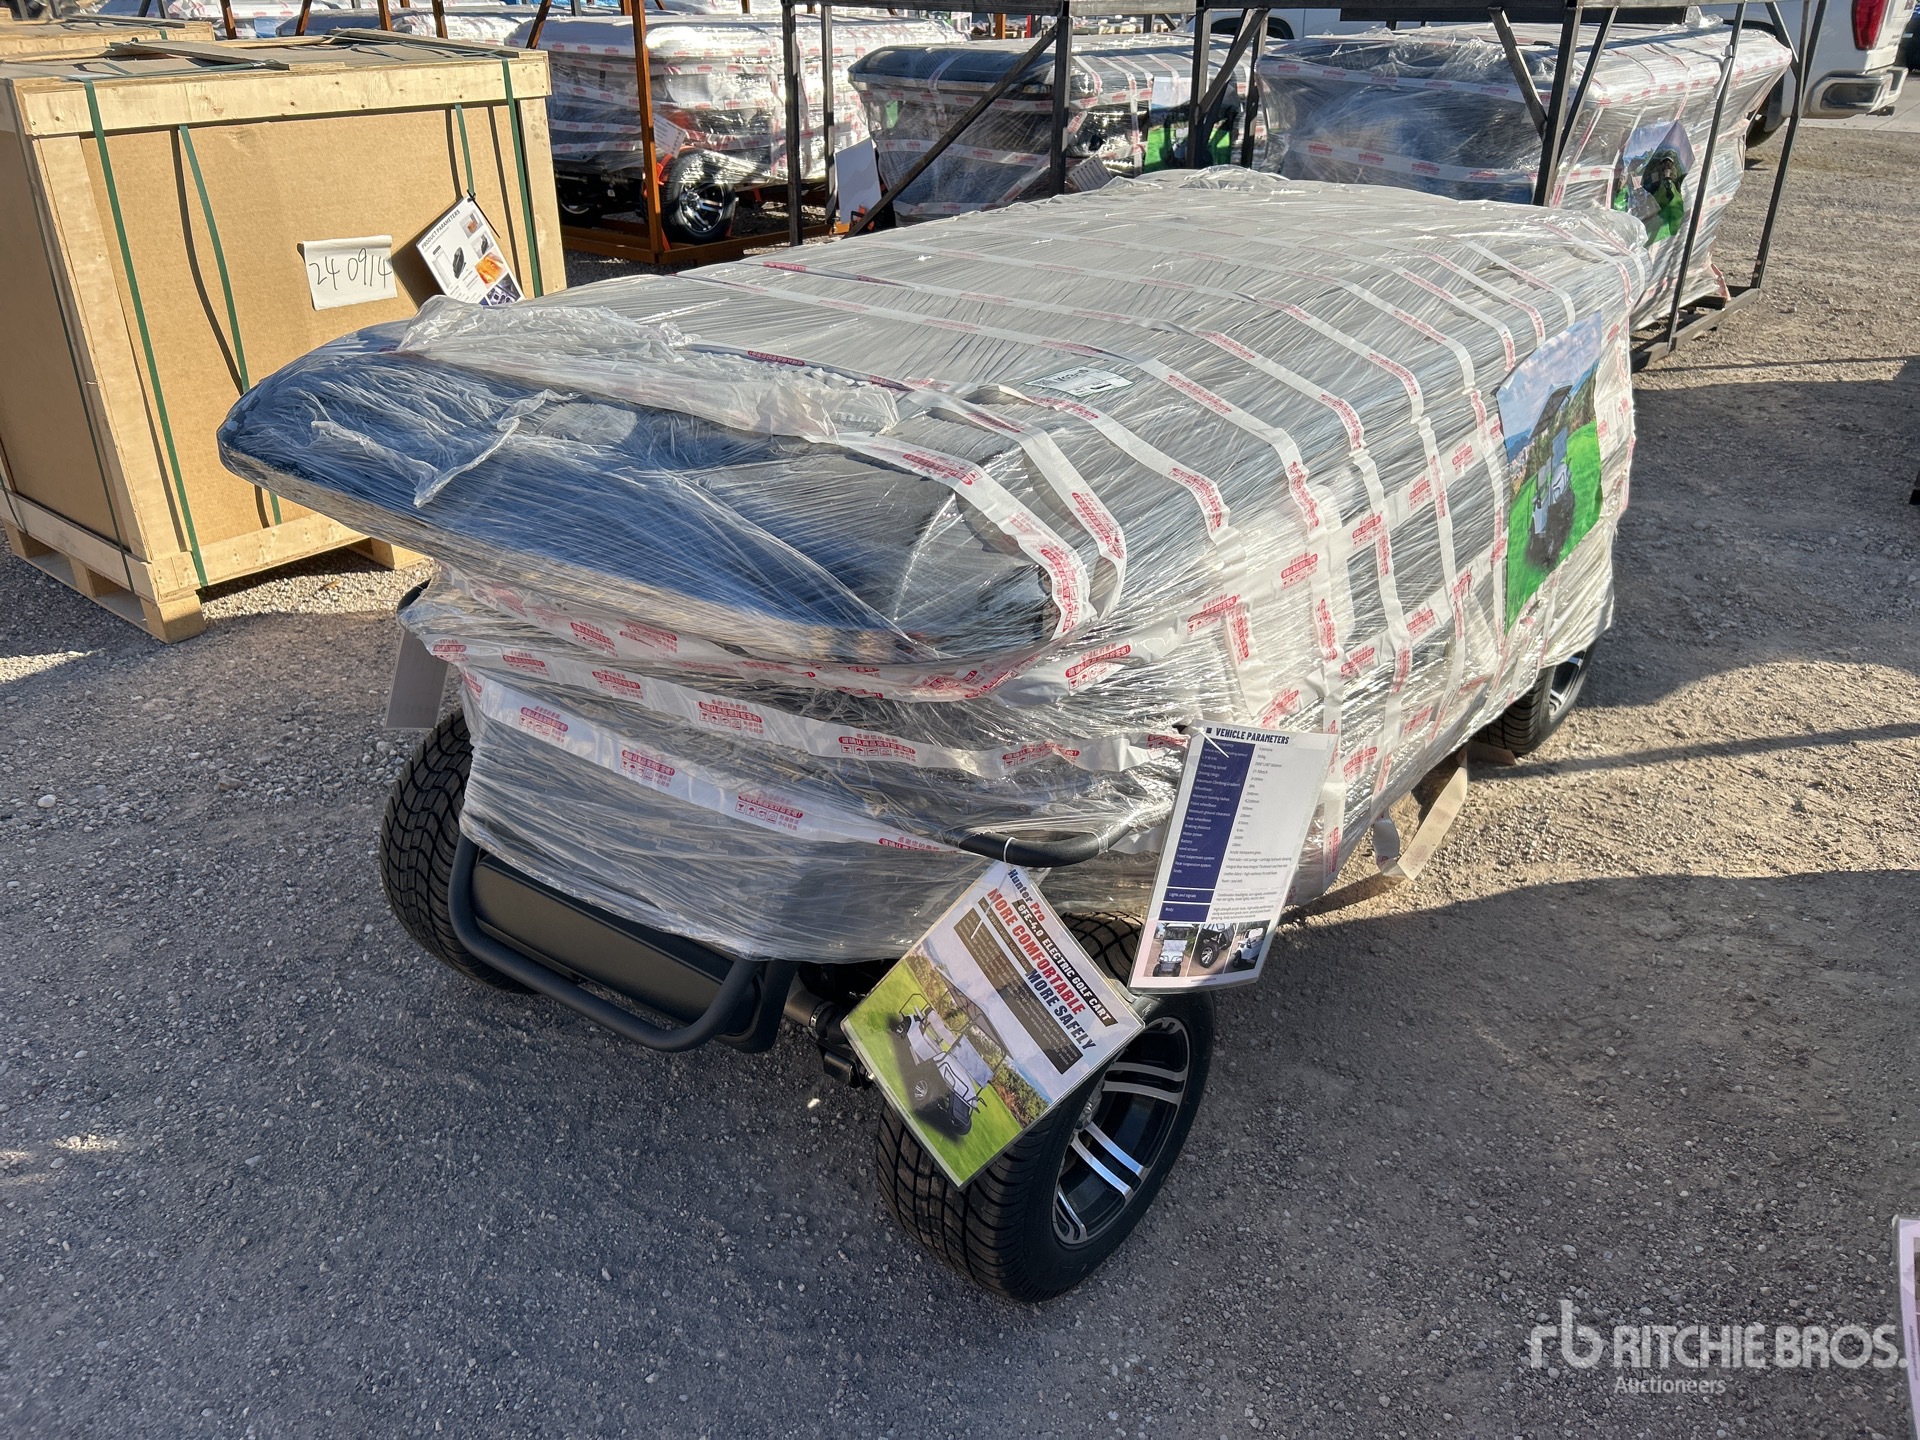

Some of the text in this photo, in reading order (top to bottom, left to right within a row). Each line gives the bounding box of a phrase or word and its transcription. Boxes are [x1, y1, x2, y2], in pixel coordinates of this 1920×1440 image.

[421, 228, 438, 250] PRODUCT
[436, 210, 460, 233] PARAMETERS
[1216, 727, 1290, 745] VEHICLE PARAMETERS
[1007, 868, 1046, 922] Hunter Pro
[986, 887, 1085, 1015] MORE COMFORTABLE
[988, 914, 1010, 944] application
[1008, 942, 1028, 968] scenarios
[1017, 903, 1111, 1022] GFE-4.0 ELECTRIC GOLF CART
[1025, 968, 1096, 1052] MORE SAFELY
